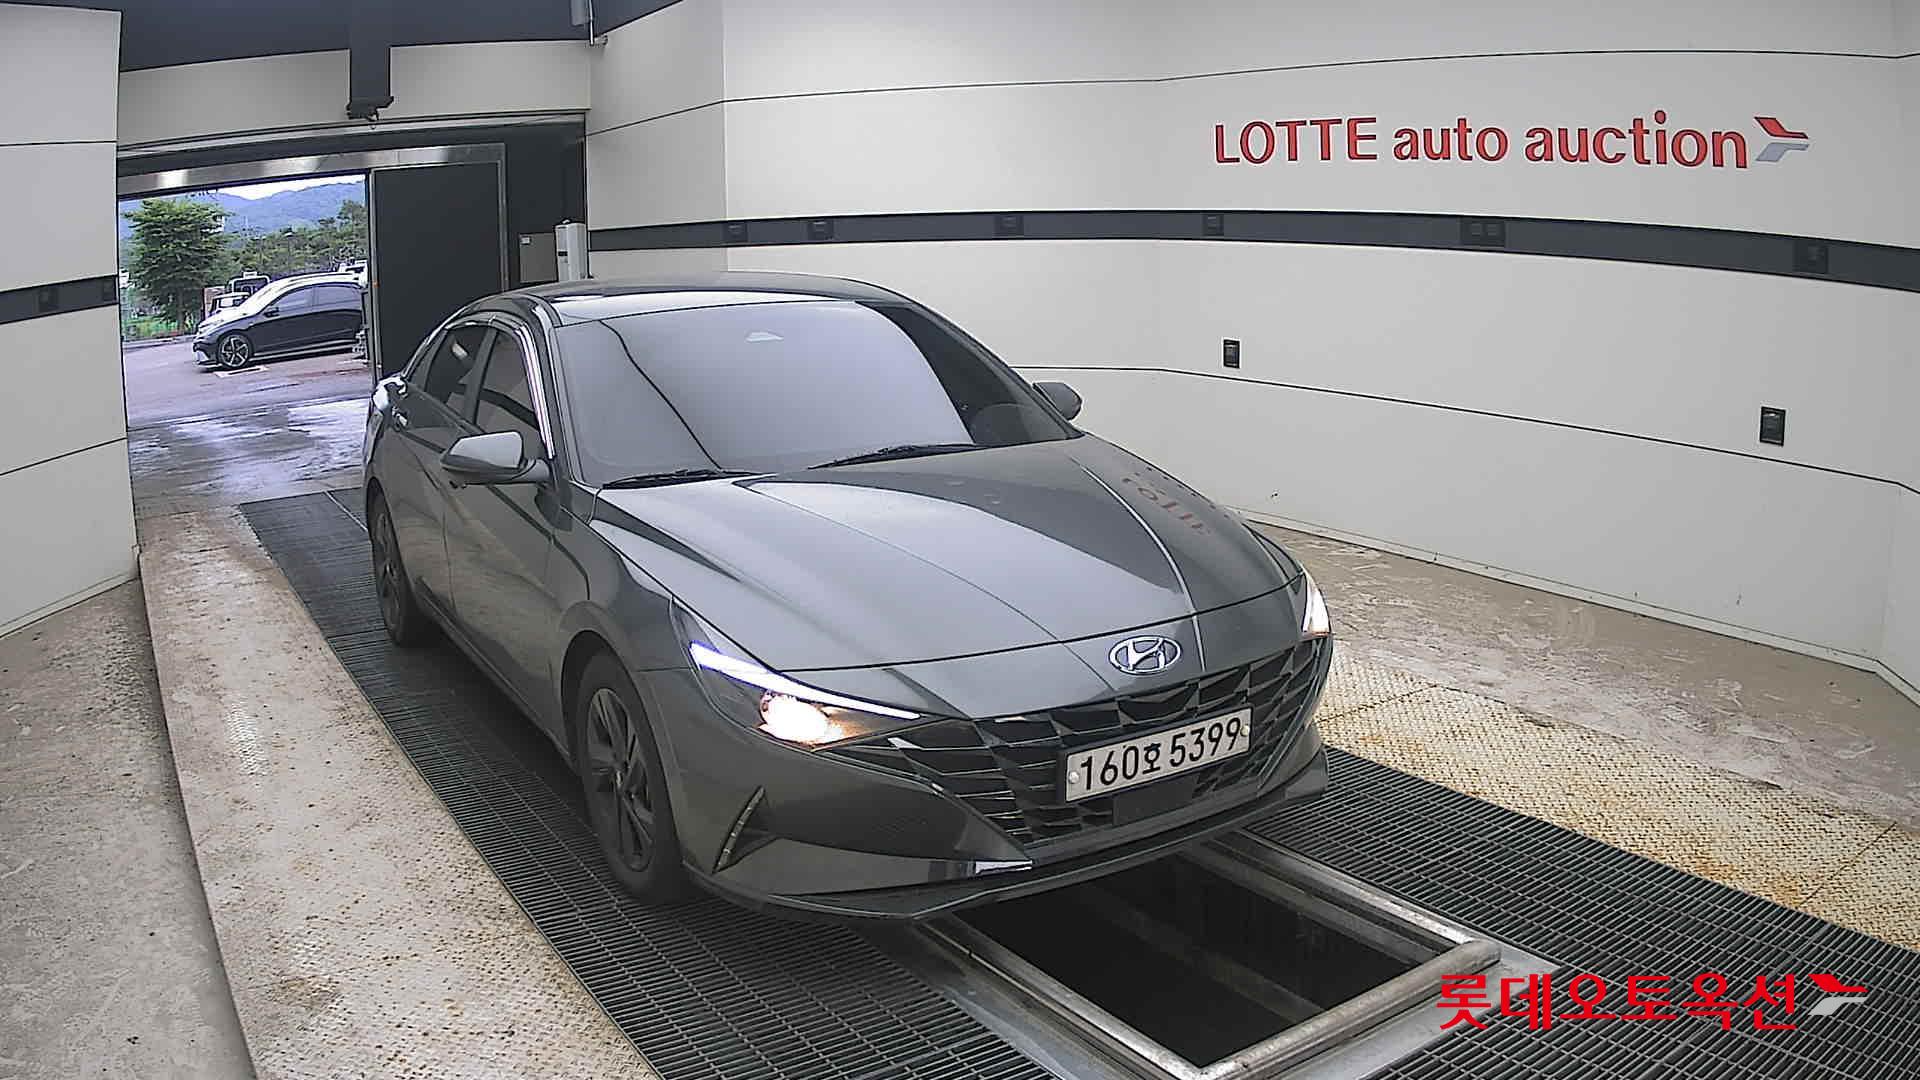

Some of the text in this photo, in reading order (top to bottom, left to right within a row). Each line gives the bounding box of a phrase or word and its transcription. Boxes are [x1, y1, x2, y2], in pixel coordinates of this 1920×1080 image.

[1215, 109, 1749, 168] LOTTE auto auction
[1169, 716, 1243, 768] 5399
